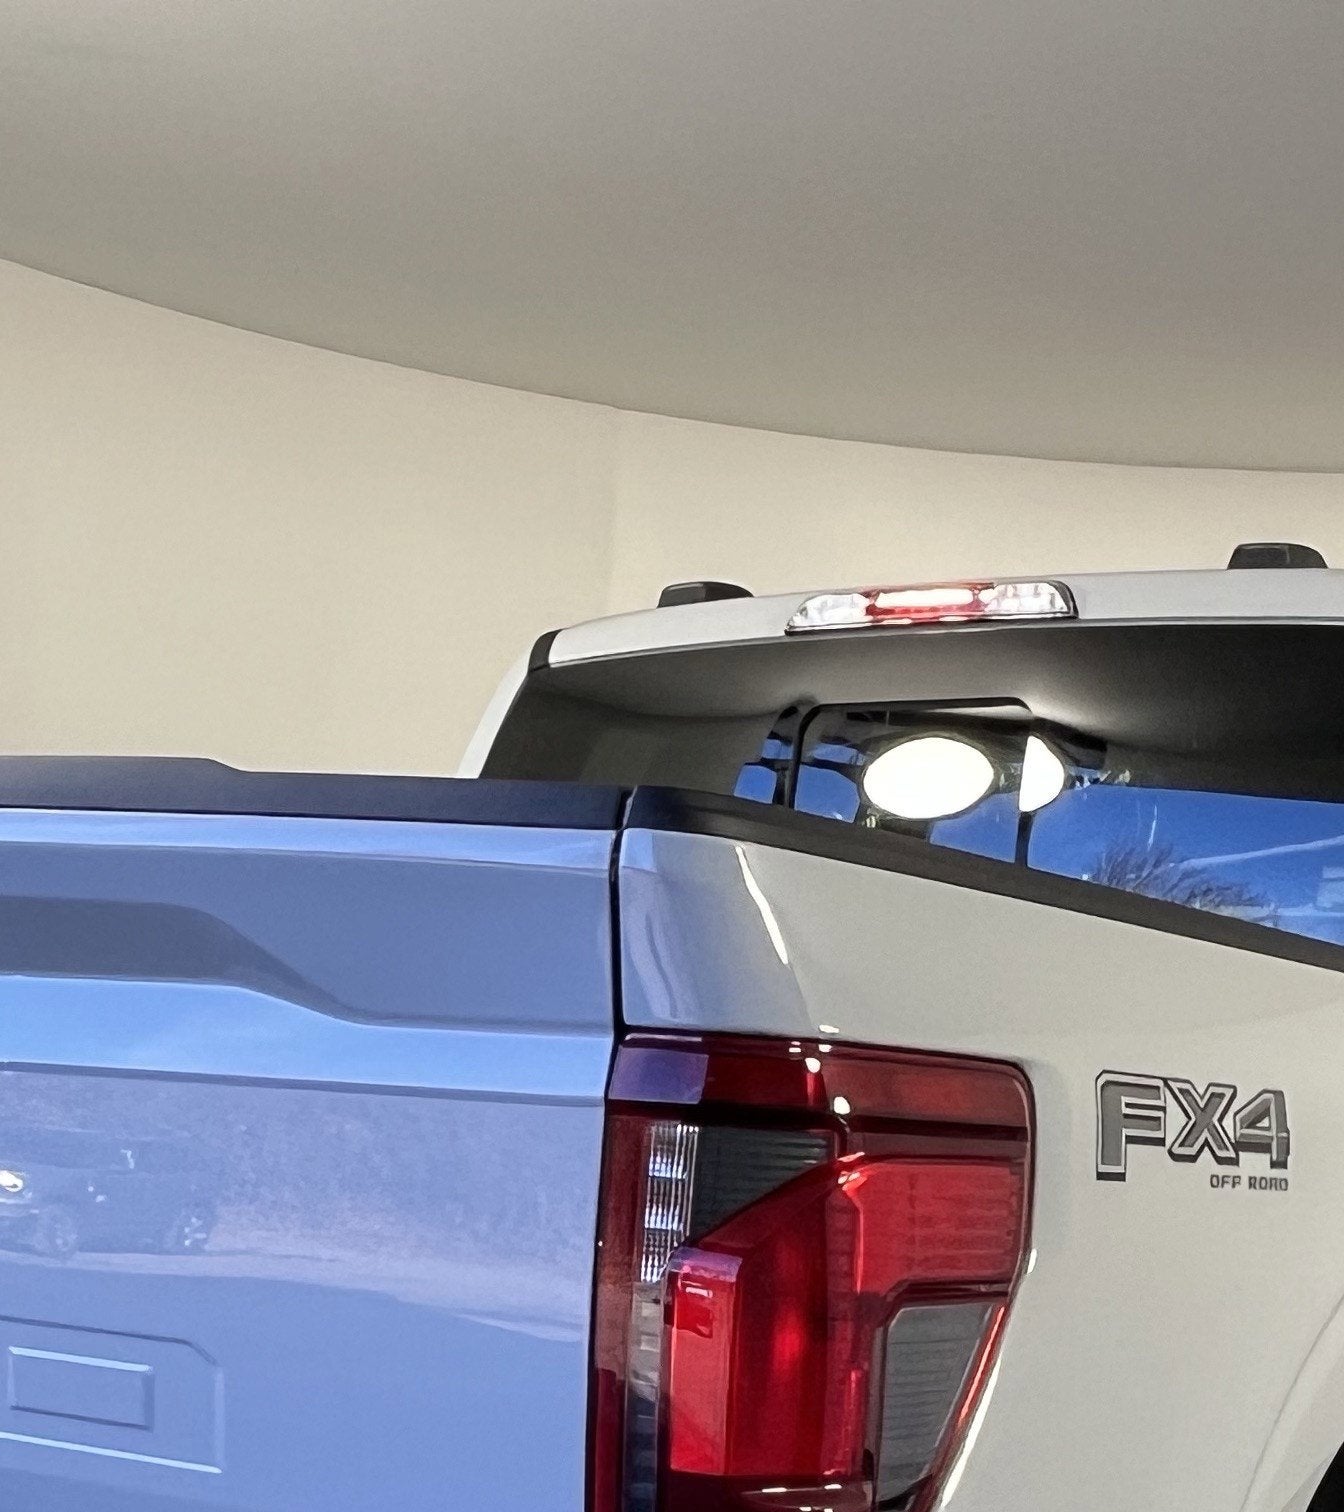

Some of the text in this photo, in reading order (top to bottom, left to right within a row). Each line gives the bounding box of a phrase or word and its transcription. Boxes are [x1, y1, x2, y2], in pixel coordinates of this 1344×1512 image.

[1094, 1069, 1291, 1182] FX4
[1209, 1173, 1289, 1191] OFF ROAD
